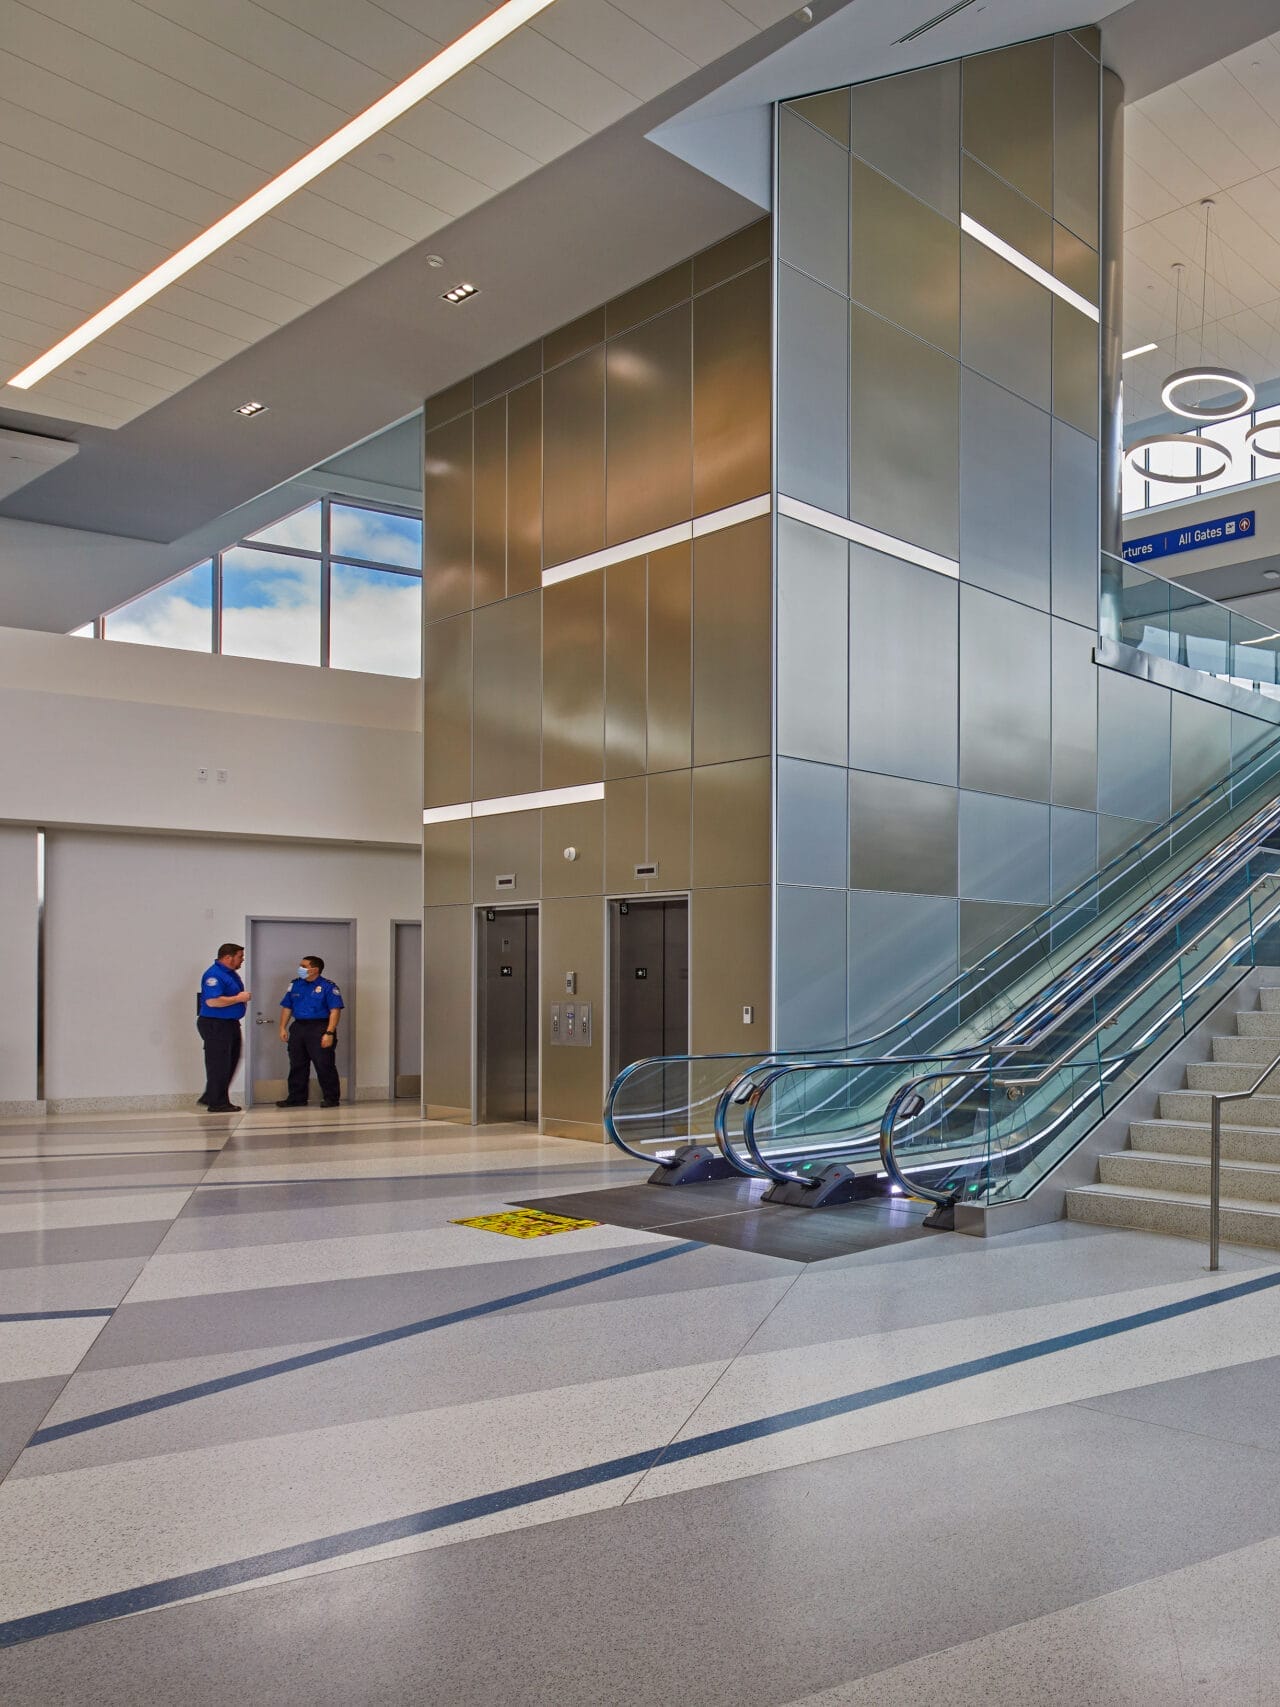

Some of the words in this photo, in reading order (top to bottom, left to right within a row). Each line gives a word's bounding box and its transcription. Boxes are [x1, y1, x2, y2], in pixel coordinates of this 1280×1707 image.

[1178, 532, 1191, 546] All
[1194, 527, 1222, 542] Gates
[1122, 544, 1153, 559] rtures
